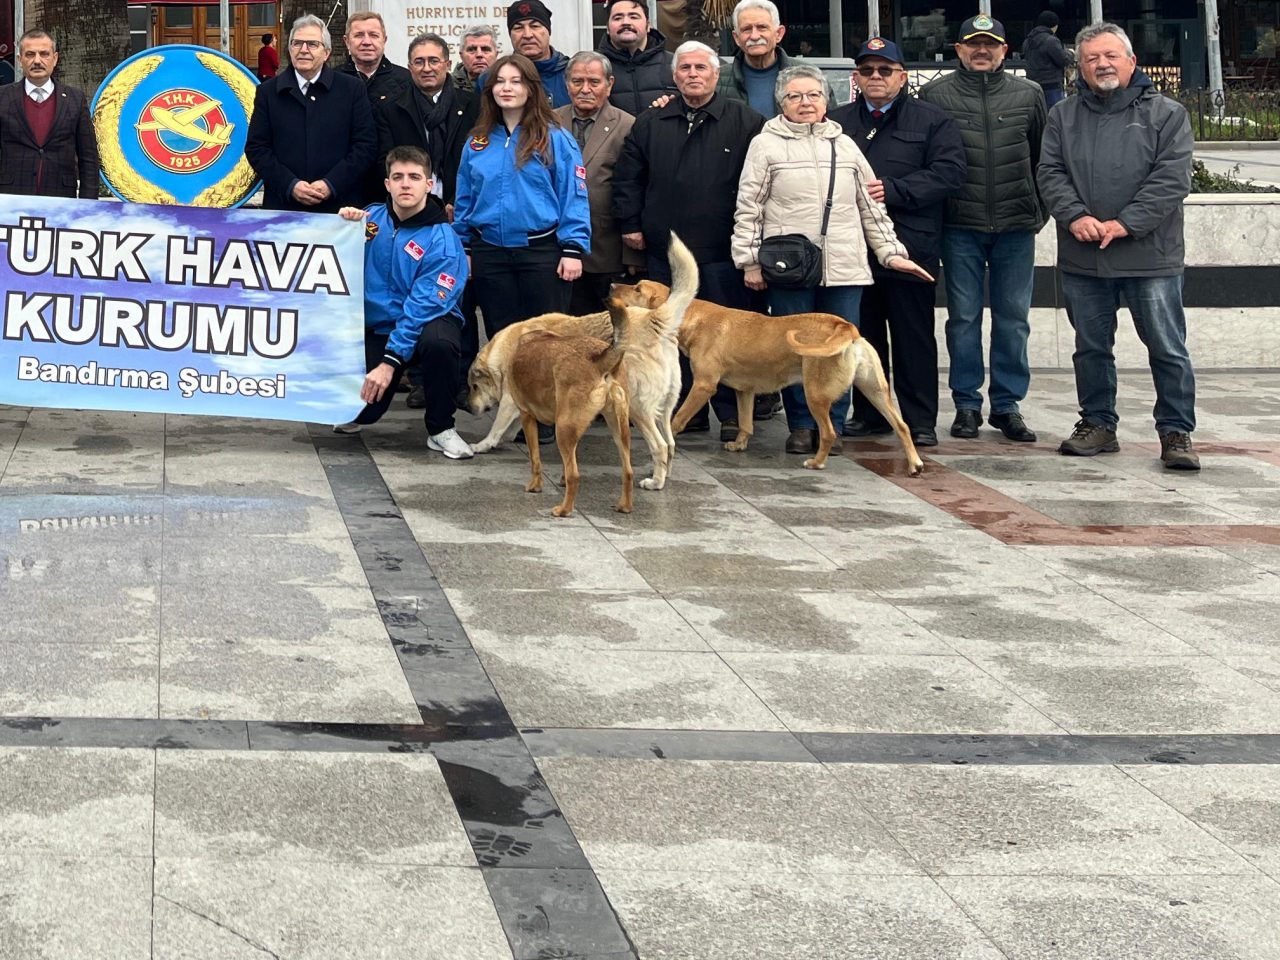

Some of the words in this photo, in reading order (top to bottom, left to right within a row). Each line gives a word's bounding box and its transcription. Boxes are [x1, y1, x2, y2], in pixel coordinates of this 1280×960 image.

[169, 155, 201, 168] 1925
[165, 234, 351, 296] HAVA
[3, 290, 298, 359] KURUMU
[17, 356, 169, 391] Bandırma
[178, 367, 286, 398] Şubesi
